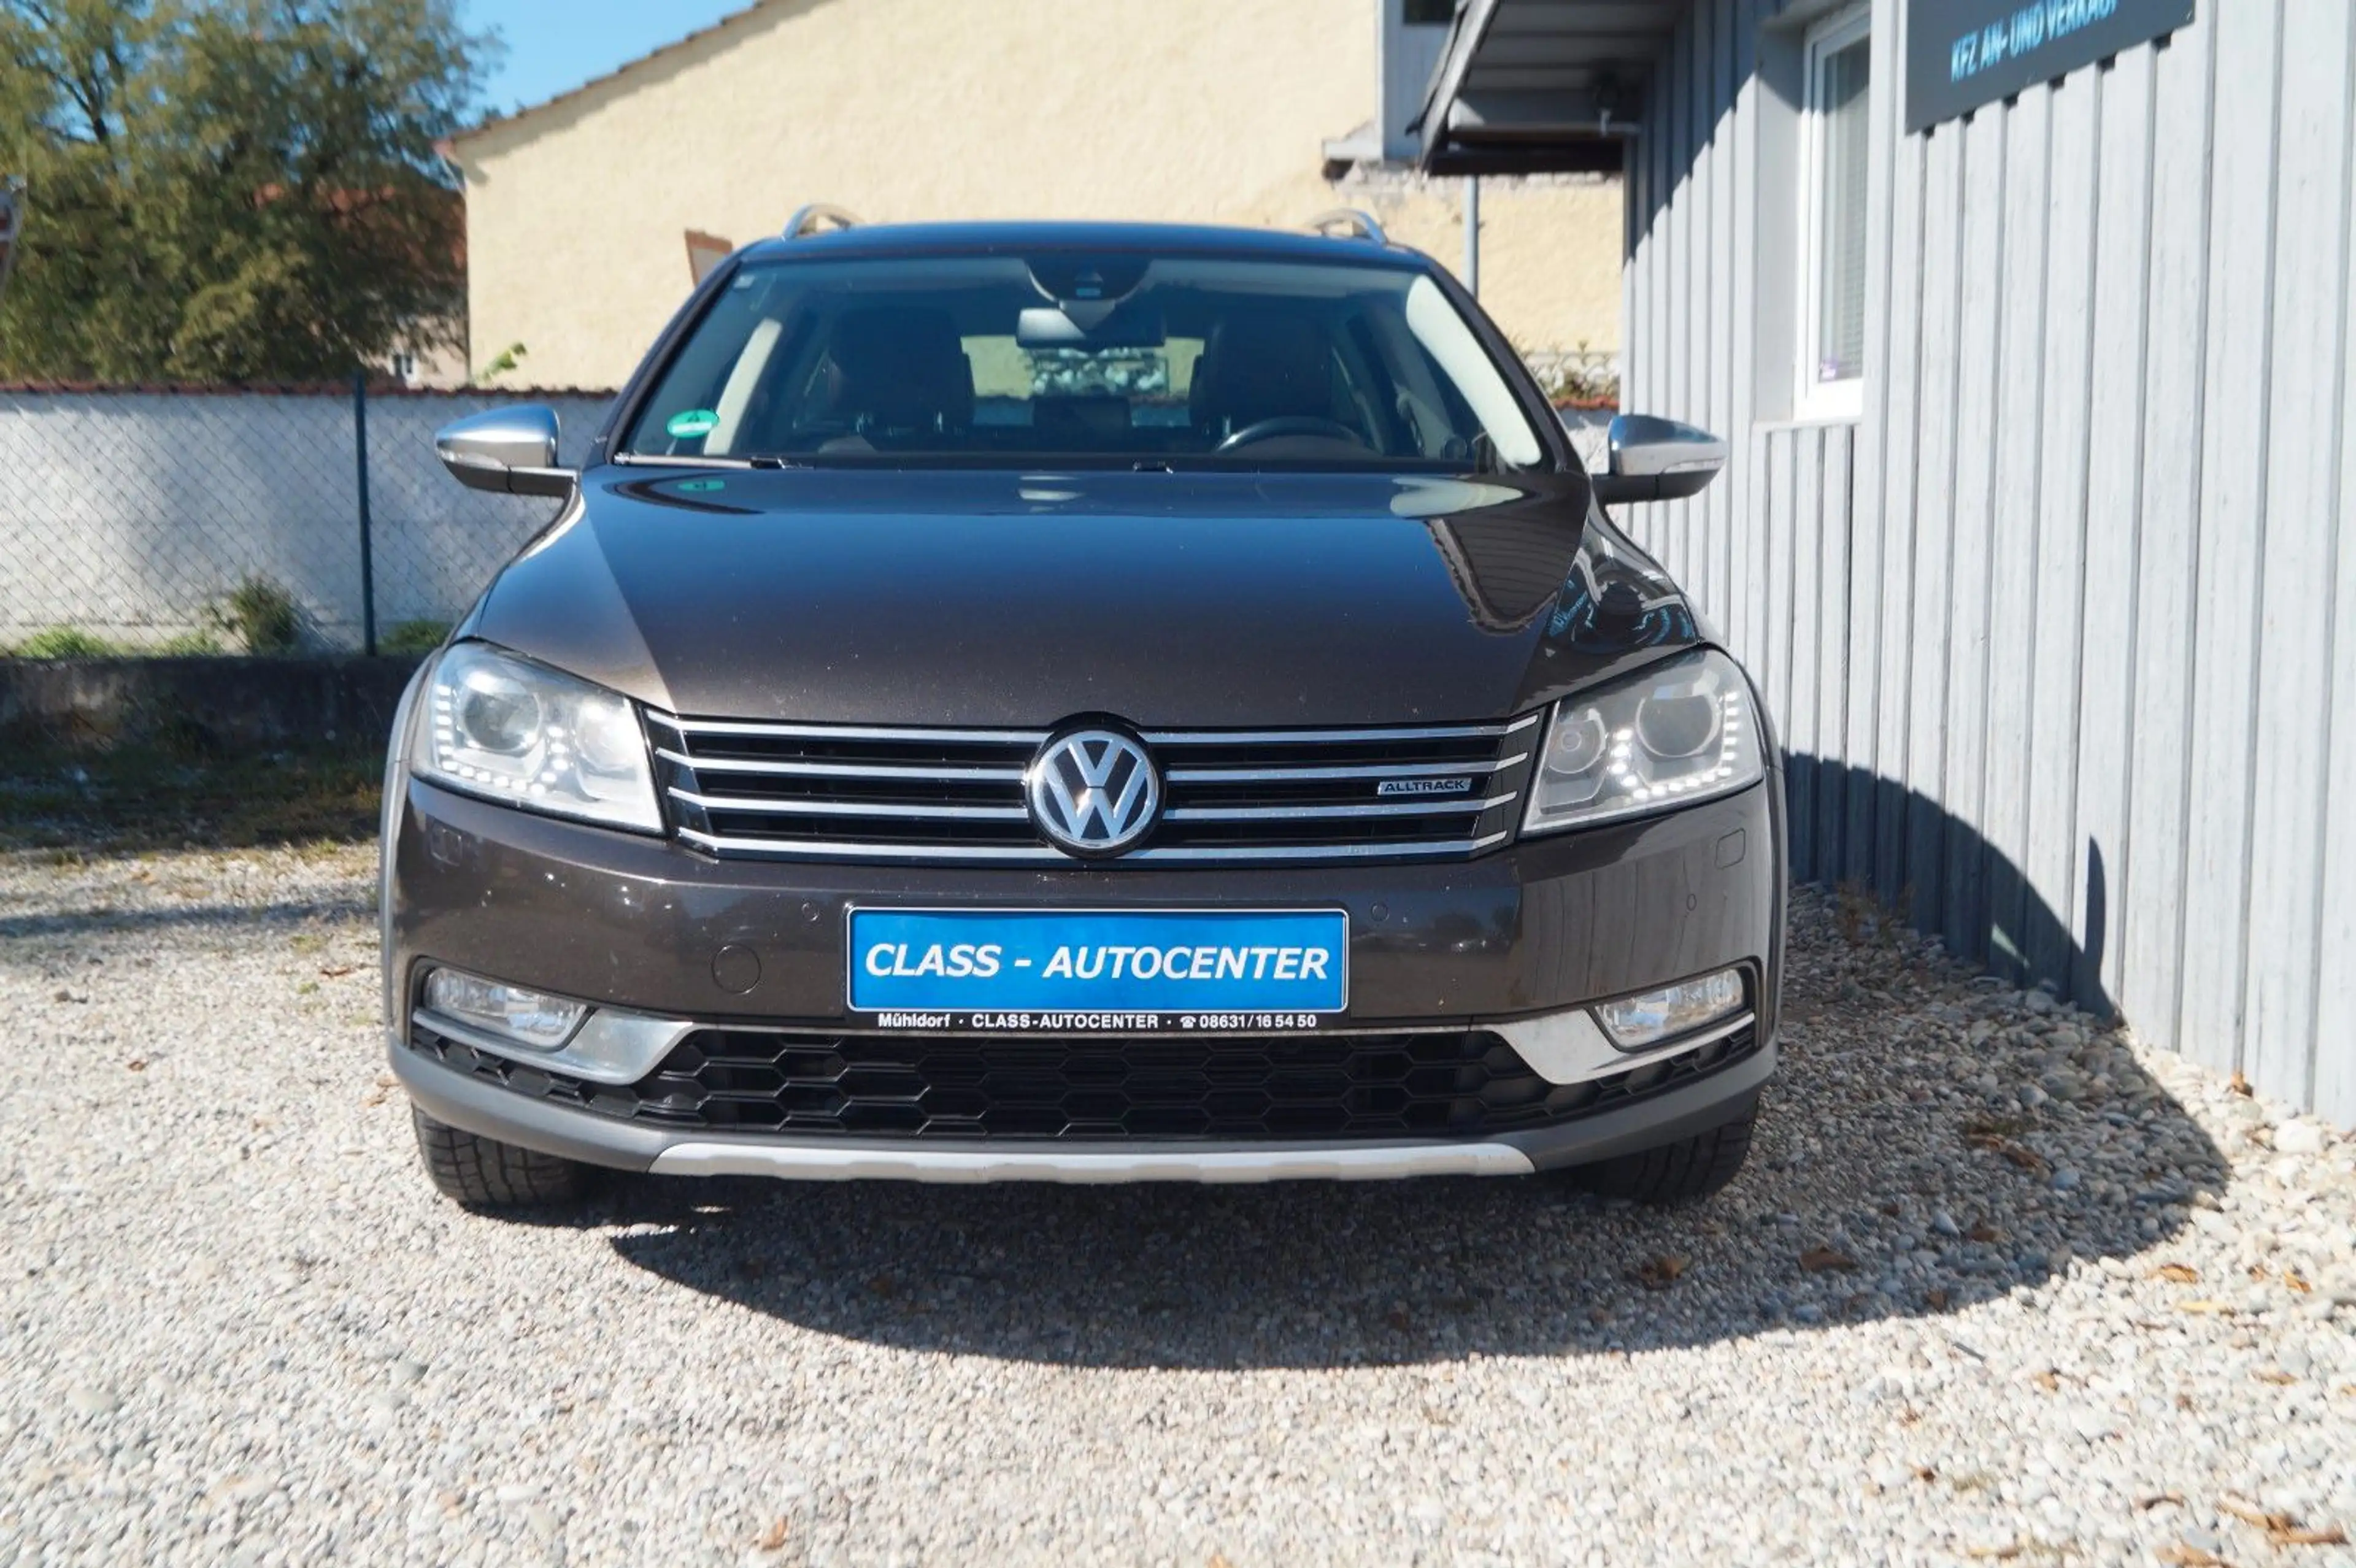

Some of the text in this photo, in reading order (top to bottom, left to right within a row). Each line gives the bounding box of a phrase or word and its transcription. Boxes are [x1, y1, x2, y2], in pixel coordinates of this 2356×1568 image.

[1950, 31, 1978, 82] KFZ
[2010, 2, 2044, 58] UND
[2046, 0, 2117, 41] VERKA
[1038, 736, 1153, 847] VW
[1384, 780, 1465, 792] ALLTRACK
[865, 942, 1003, 978] CLASS
[1042, 945, 1330, 980] AUTOCENTER
[877, 1012, 951, 1028] Mühldorf
[971, 1013, 1159, 1029] CLASS-AUTOCENTER
